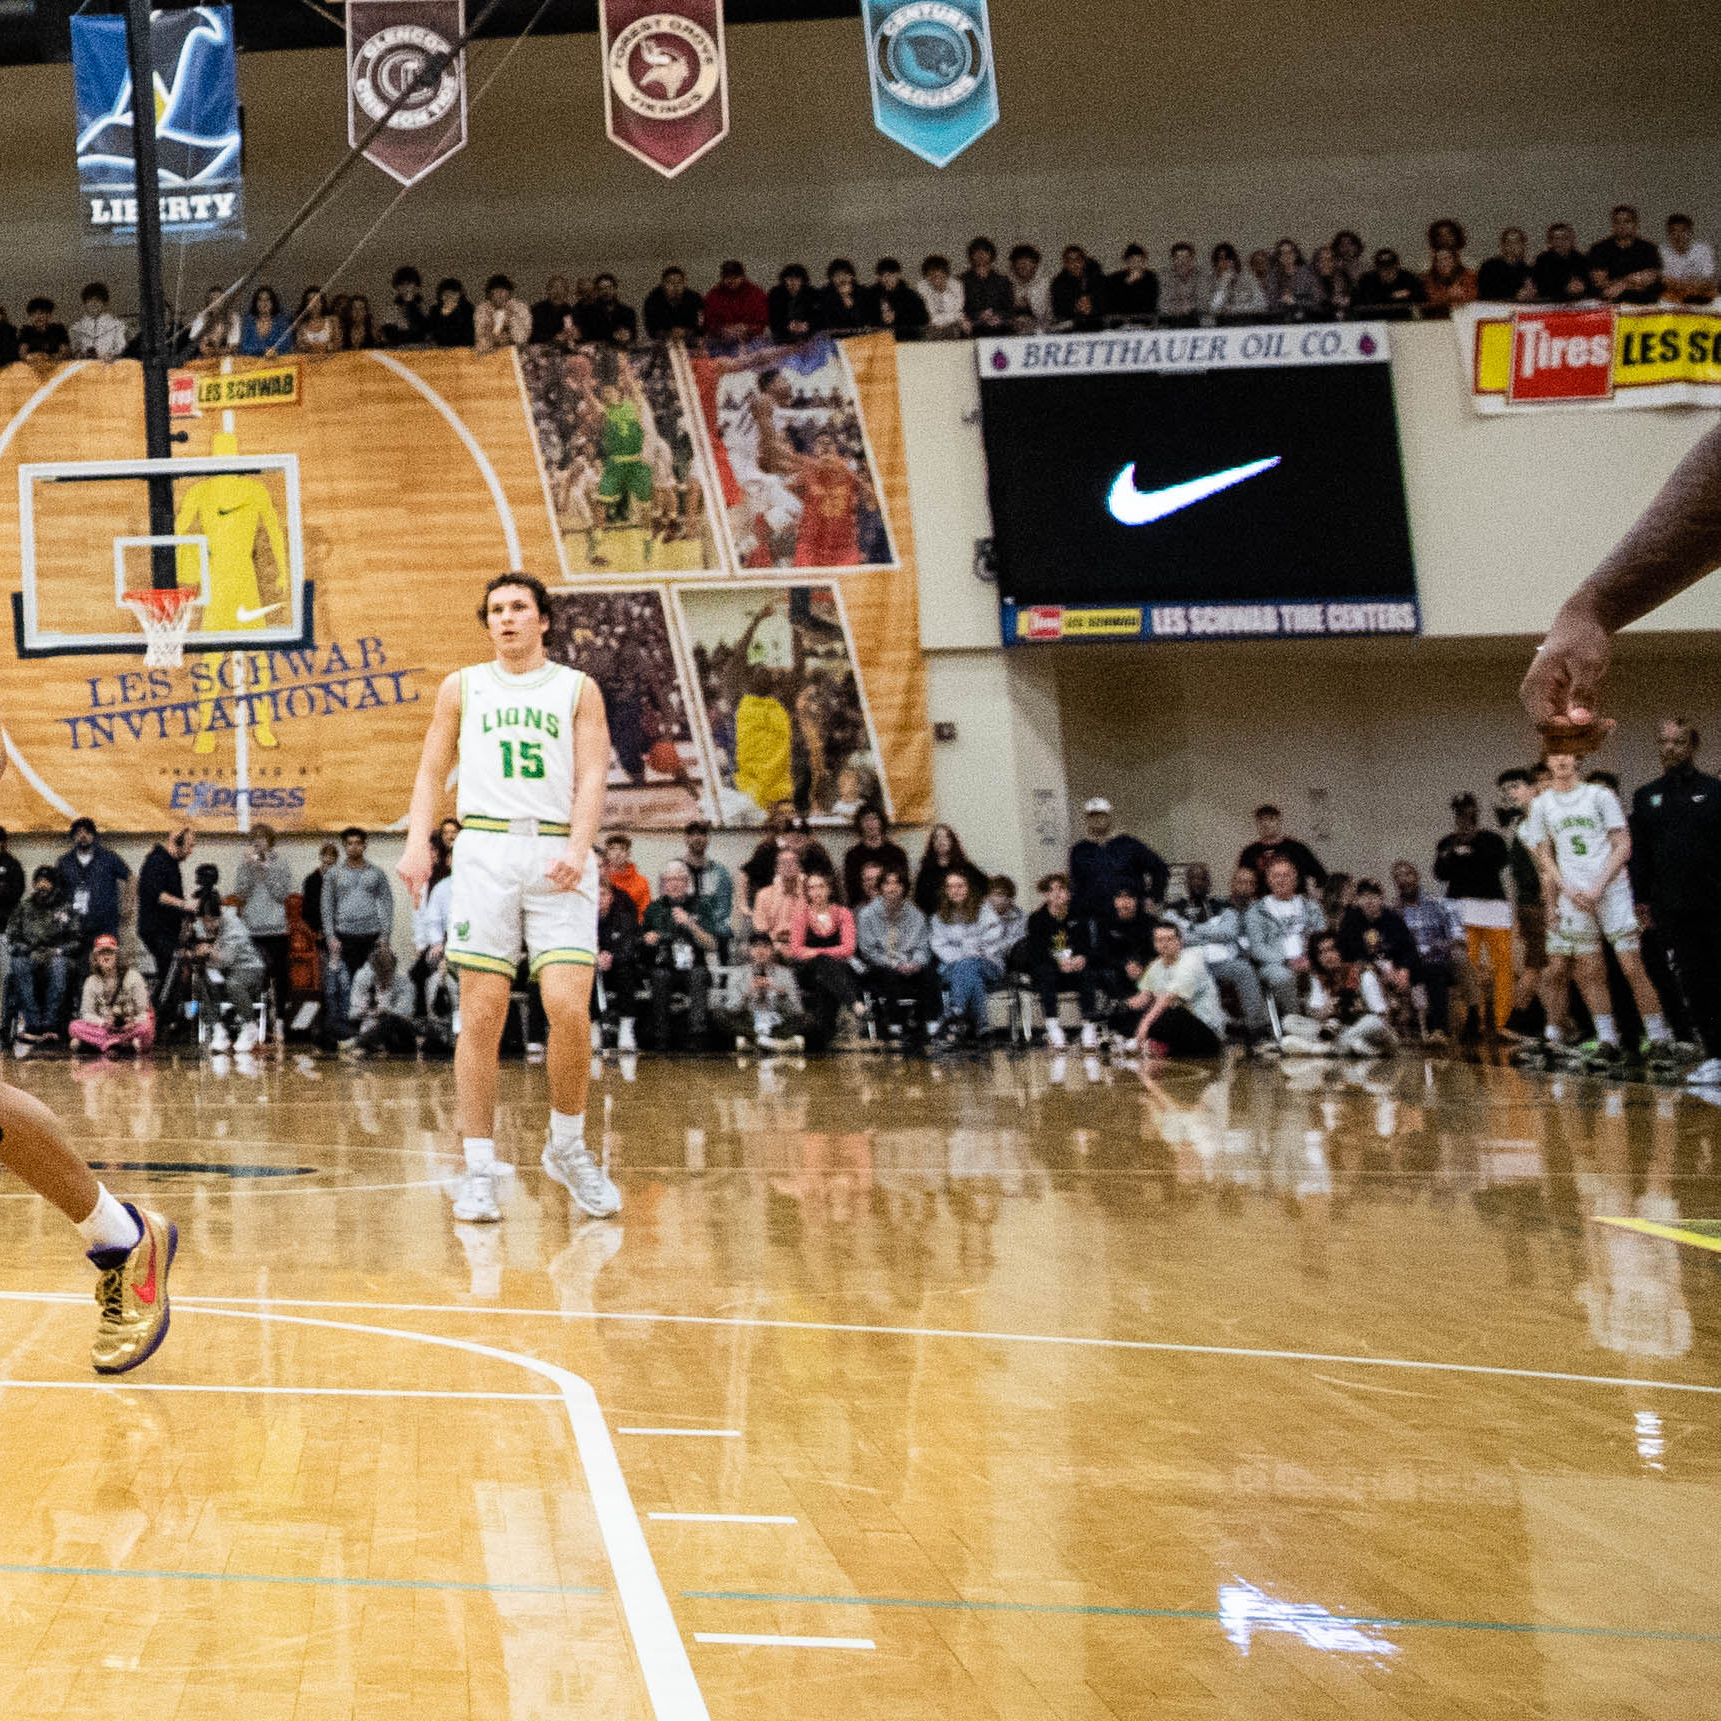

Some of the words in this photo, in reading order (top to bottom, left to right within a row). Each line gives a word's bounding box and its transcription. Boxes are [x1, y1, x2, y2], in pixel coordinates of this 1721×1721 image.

[883, 9, 971, 36] CENTURY
[613, 22, 664, 69] FOREST
[669, 19, 715, 66] GROVE
[629, 91, 703, 115] VIKINGS
[1240, 329, 1289, 358] OIL
[1517, 319, 1609, 379] Tires
[1623, 329, 1680, 367] LES
[197, 382, 222, 402] LES
[226, 374, 293, 400] SCHWAB
[1152, 610, 1185, 634] LES
[1189, 607, 1277, 634] SCHWAB
[1328, 603, 1416, 630] CENTERS
[89, 669, 172, 708] LES
[190, 637, 386, 695] SCHWAB
[59, 668, 423, 752] INVITATIONAL
[482, 706, 560, 739] LIONS
[499, 740, 546, 779] 15
